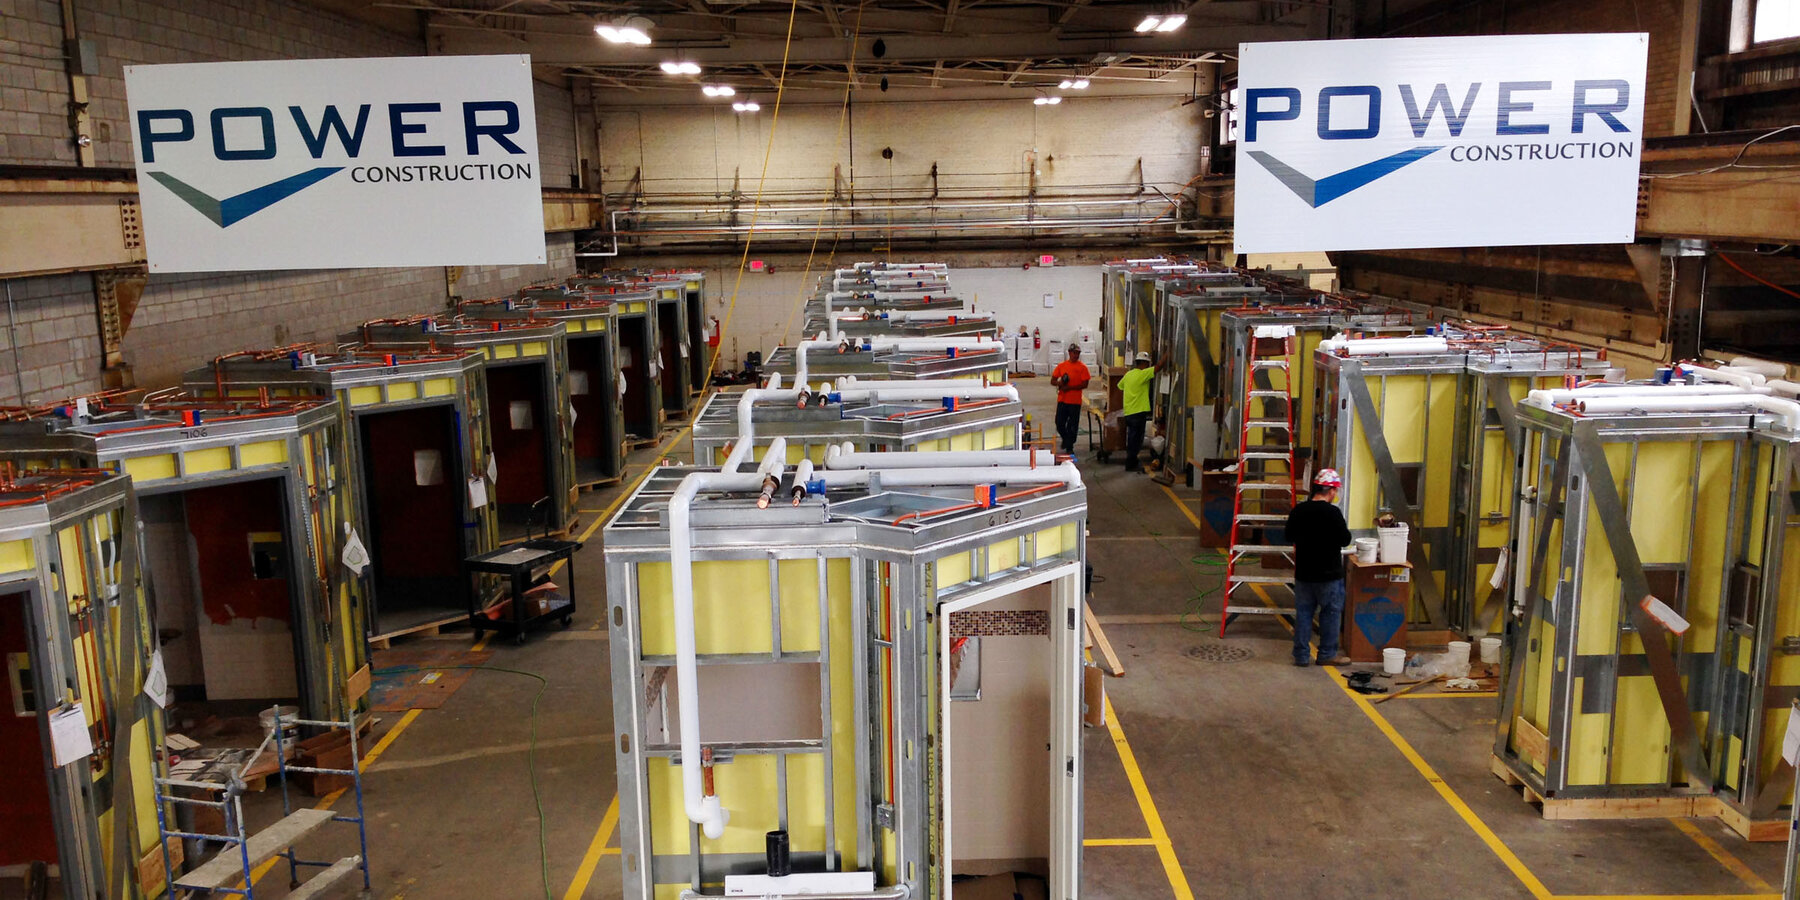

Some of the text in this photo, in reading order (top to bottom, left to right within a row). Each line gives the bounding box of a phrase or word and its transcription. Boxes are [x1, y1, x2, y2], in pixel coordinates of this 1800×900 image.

[1244, 79, 1631, 142] POWER
[137, 100, 527, 163] POWER
[1450, 141, 1633, 162] CONSTRUCTION
[351, 163, 532, 183] CONSTRUCTION
[180, 427, 208, 439] 7106
[988, 509, 1022, 527] 6150
